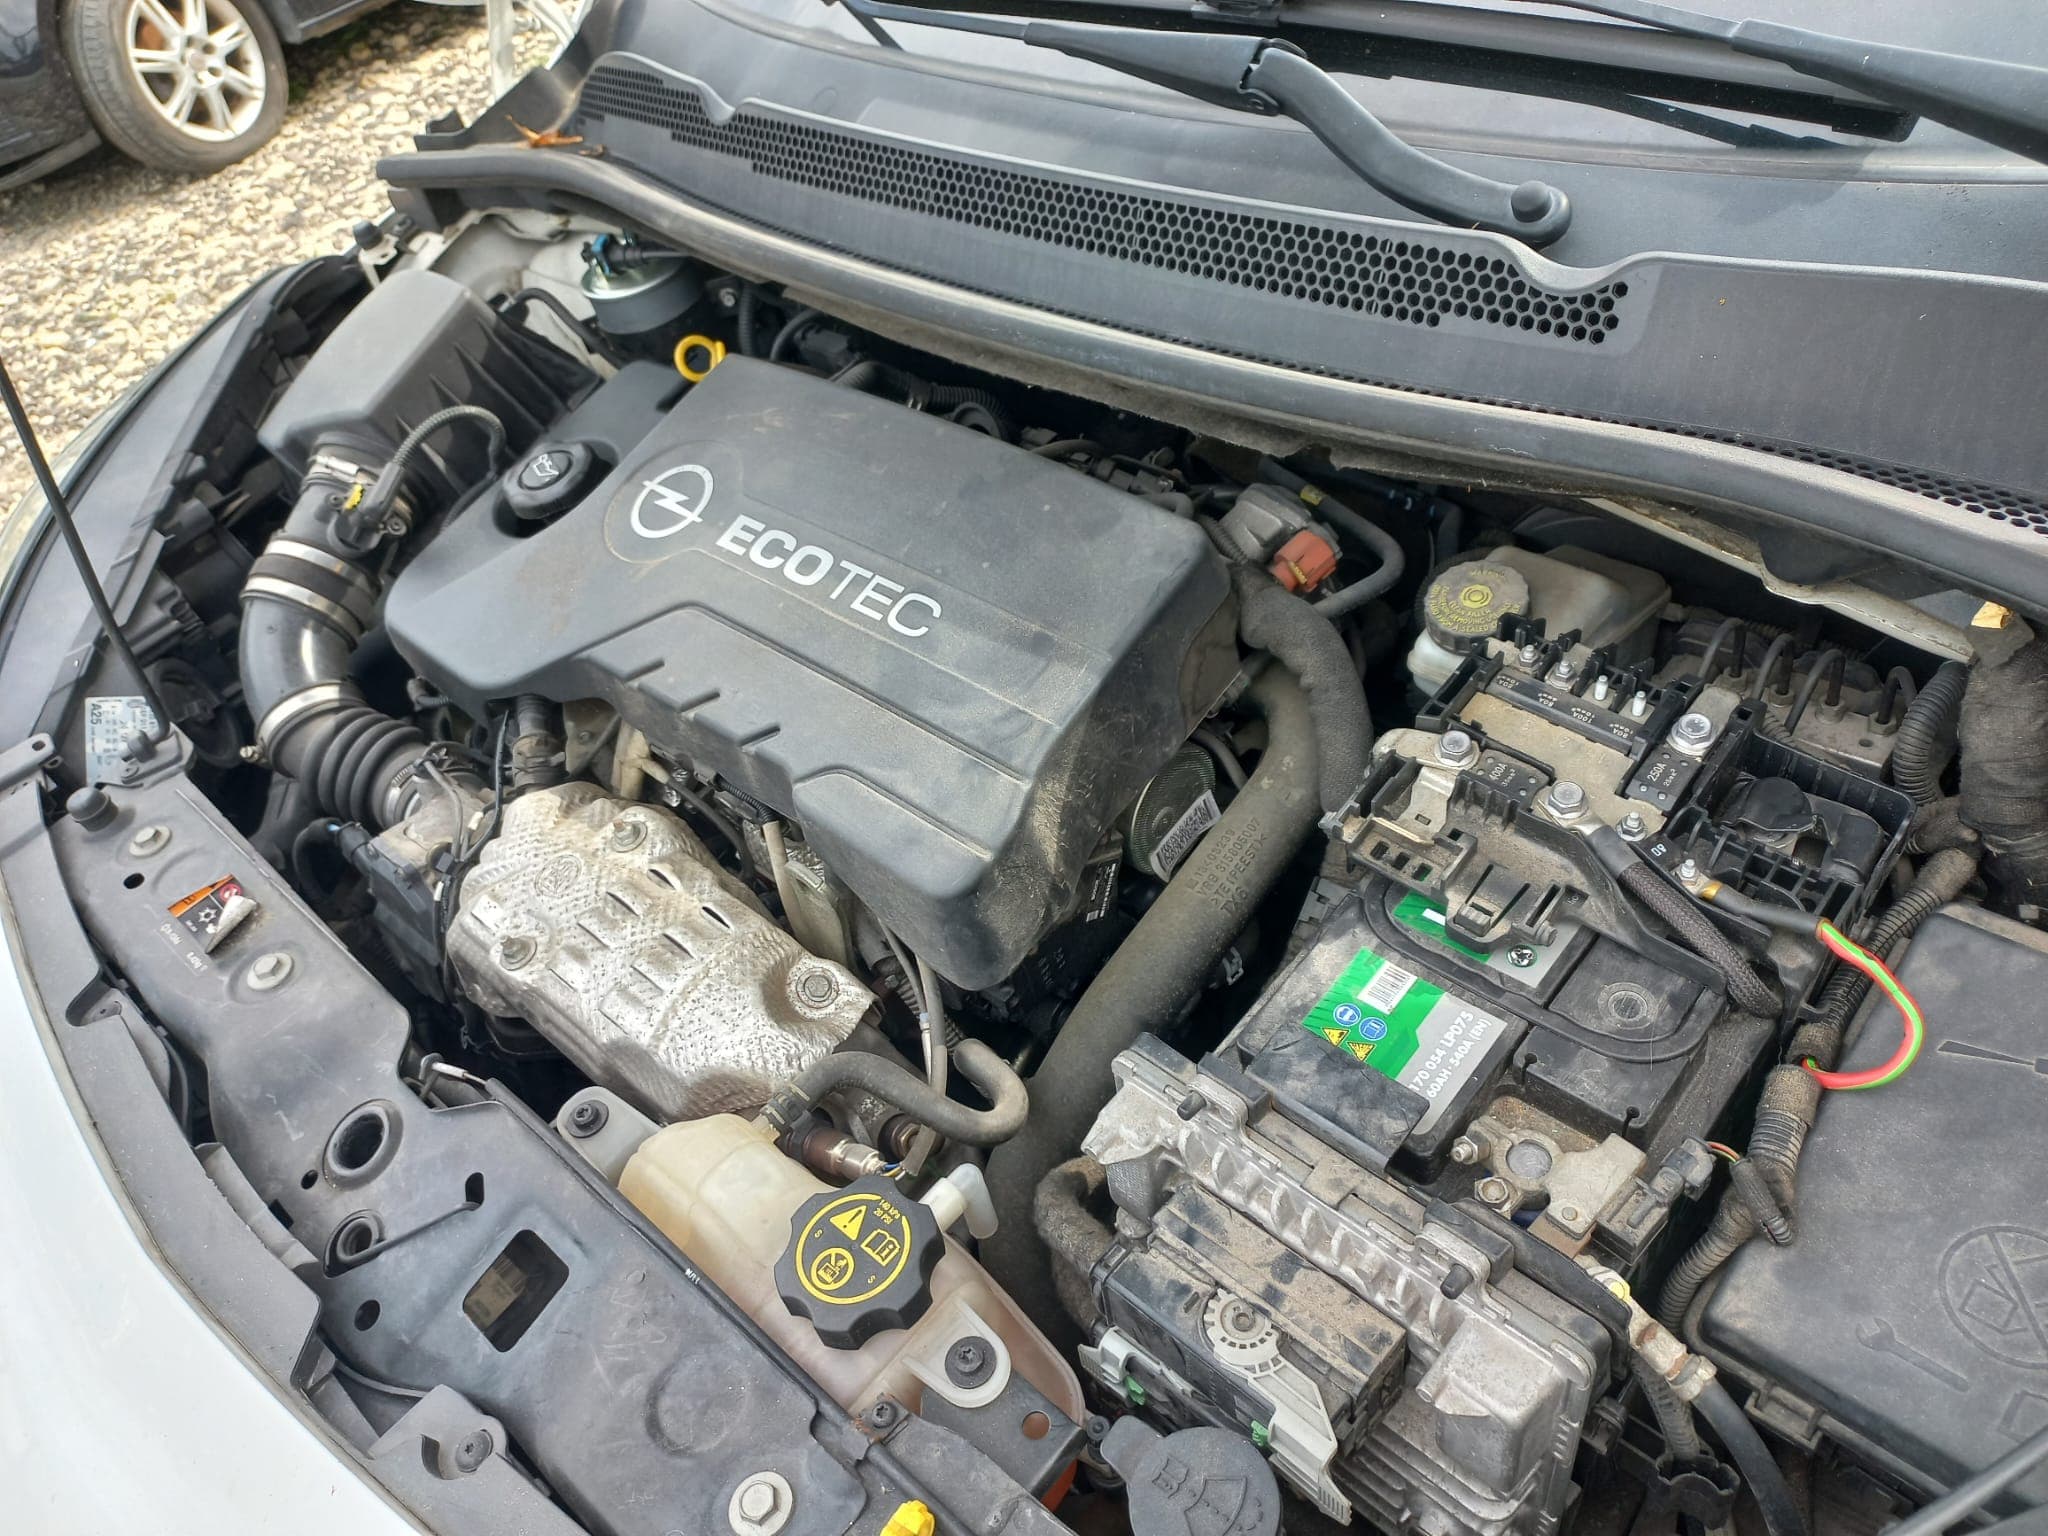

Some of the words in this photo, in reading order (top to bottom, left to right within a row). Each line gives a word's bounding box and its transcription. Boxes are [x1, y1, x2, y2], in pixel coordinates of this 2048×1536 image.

[716, 515, 942, 637] ECOTEC
[91, 703, 102, 725] A25
[1572, 711, 1592, 724] 100A
[1489, 762, 1507, 781] 400A
[1647, 762, 1667, 782] 250A
[1425, 1047, 1446, 1069] 054
[1440, 1011, 1473, 1047] LP075
[1468, 1018, 1492, 1041] (EN)
[873, 1207, 884, 1216] 20
[880, 1213, 893, 1224] PSI
